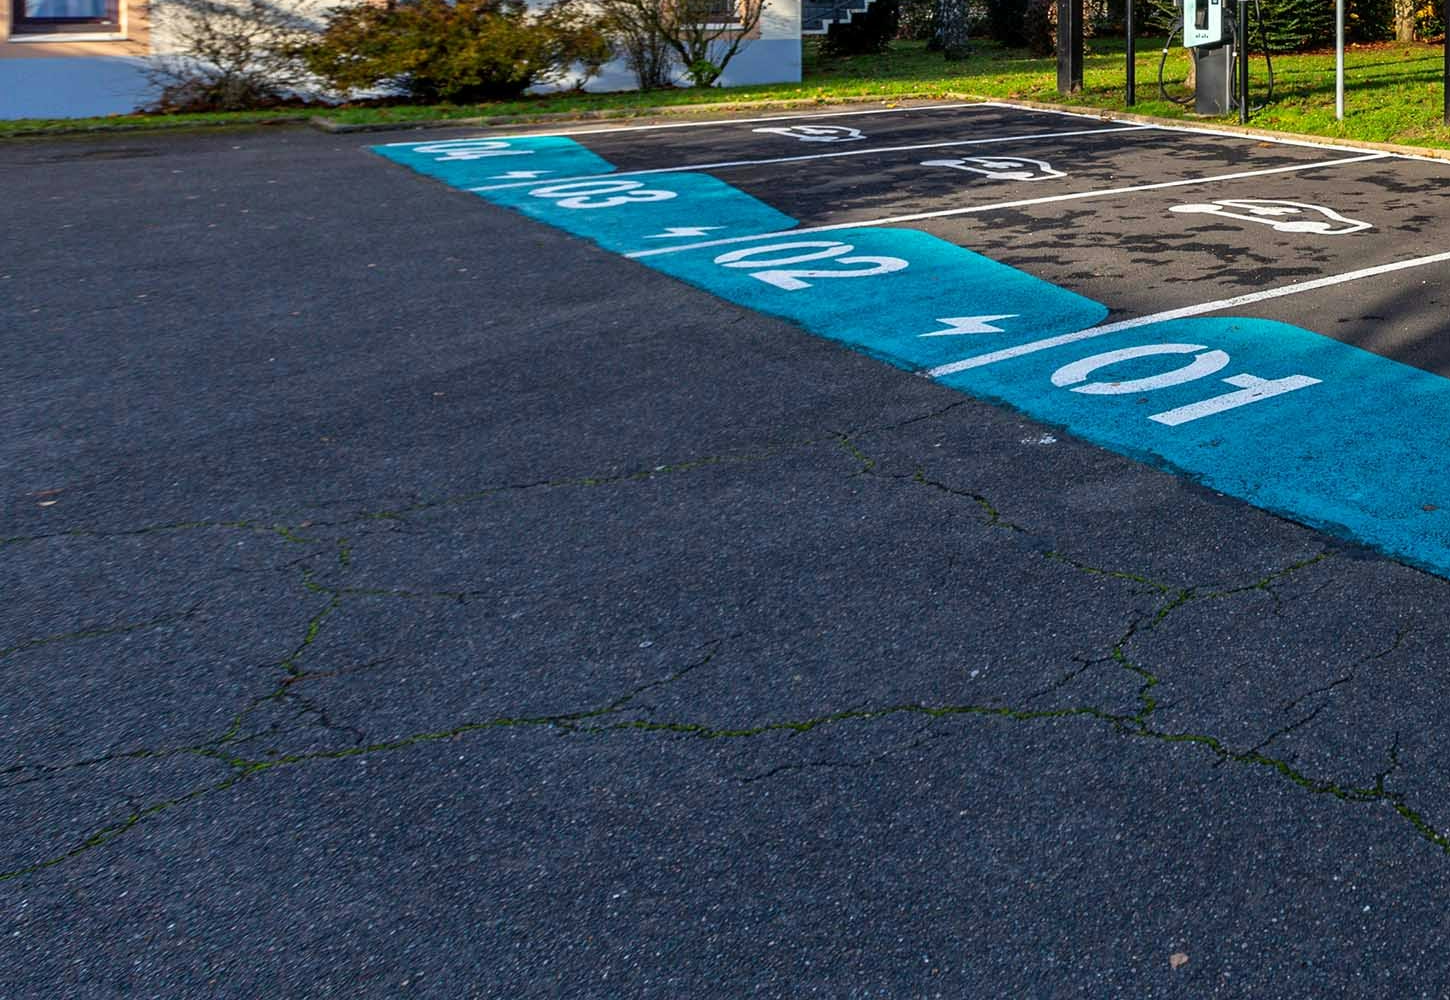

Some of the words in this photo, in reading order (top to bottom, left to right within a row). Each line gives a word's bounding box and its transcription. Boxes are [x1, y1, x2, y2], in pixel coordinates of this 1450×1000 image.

[527, 180, 679, 209] 03
[713, 241, 910, 291] 02
[1050, 343, 1324, 426] 01
